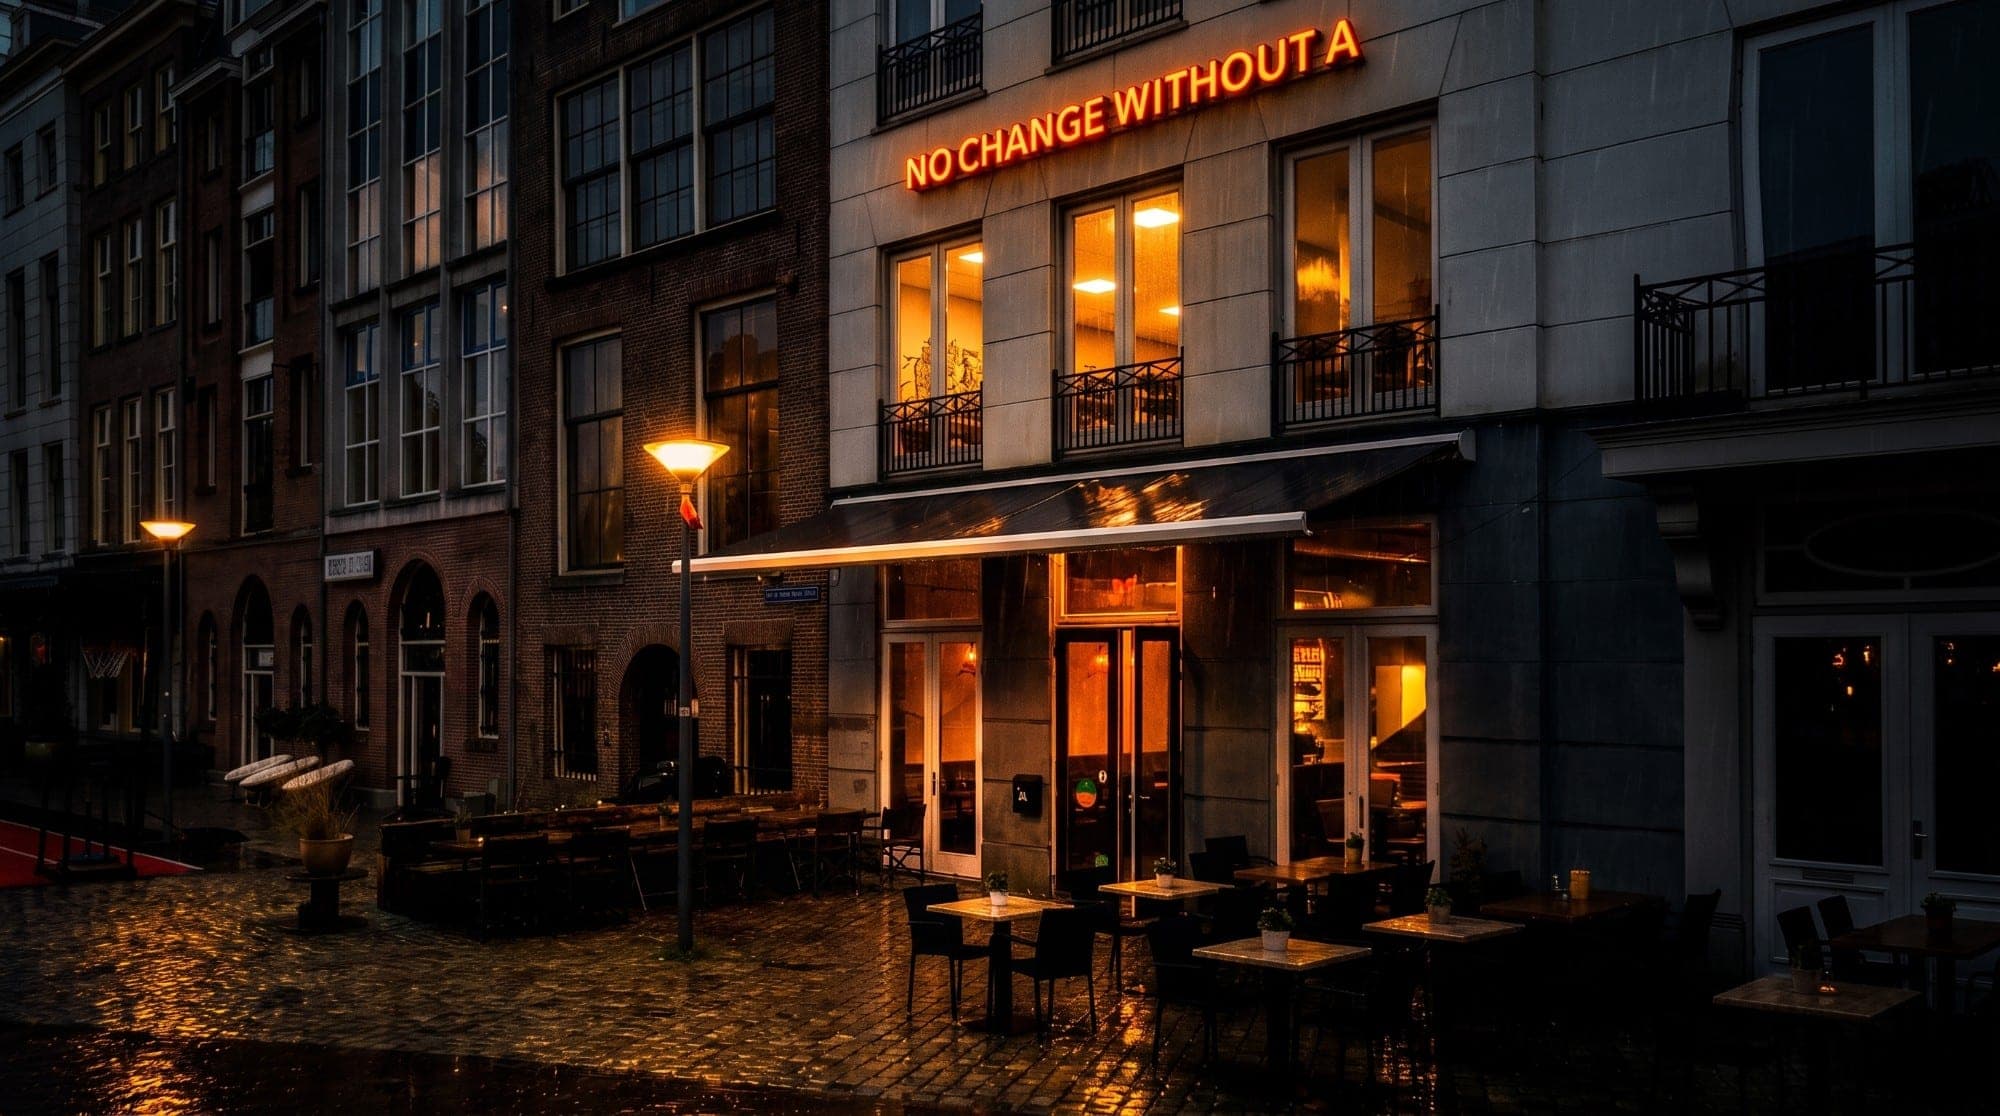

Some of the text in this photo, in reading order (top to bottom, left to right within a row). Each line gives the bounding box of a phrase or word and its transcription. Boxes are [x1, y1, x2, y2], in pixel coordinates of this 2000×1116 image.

[906, 18, 1362, 191] NO CHANGE WITHOUT A
